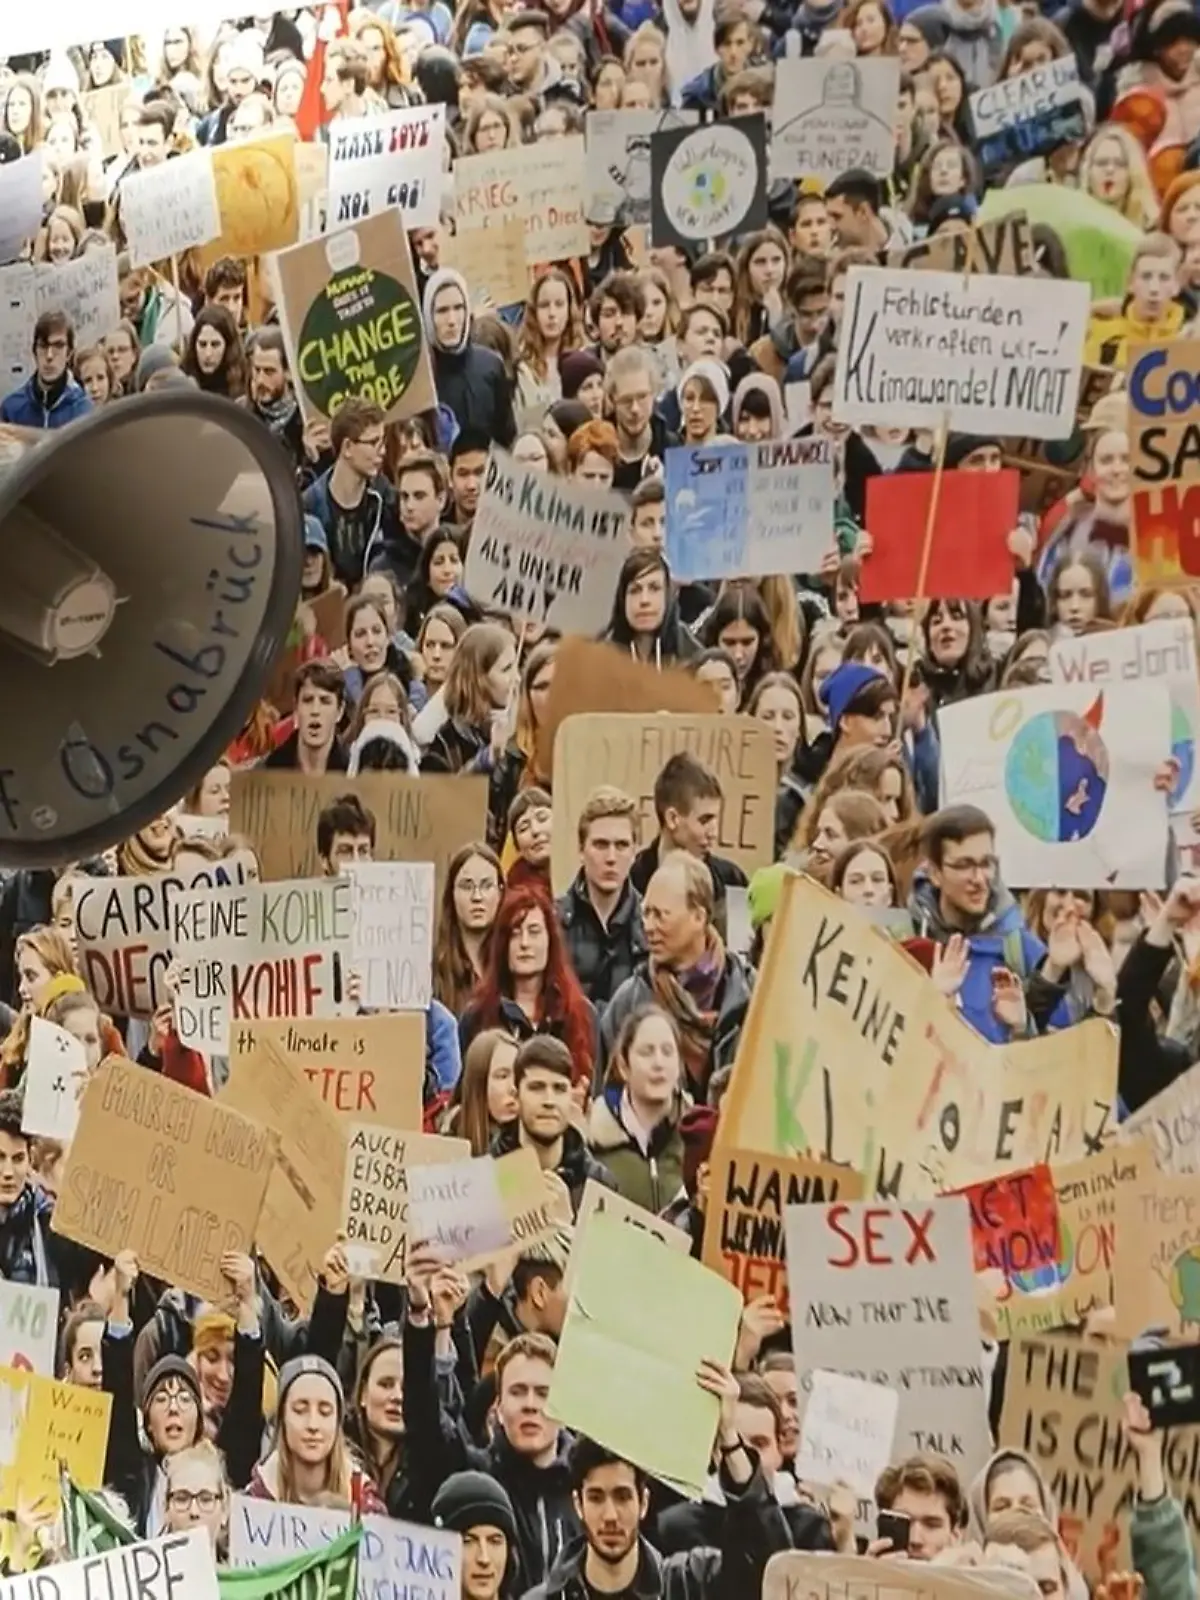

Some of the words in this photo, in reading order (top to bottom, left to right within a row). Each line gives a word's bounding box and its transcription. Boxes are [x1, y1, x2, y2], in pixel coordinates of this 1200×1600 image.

[977, 73, 1046, 119] CLEAR
[334, 129, 384, 160] MAKE
[388, 120, 428, 153] LOVE
[337, 188, 370, 222] NOT
[882, 287, 1024, 327] Fehlstunden
[299, 301, 416, 382] CHANGE
[845, 281, 998, 408] Klimawandel
[886, 327, 992, 357] verkraften
[328, 364, 405, 416] GOBE
[345, 360, 377, 384] THE
[485, 456, 514, 503] DAS
[518, 472, 586, 534] KLIMA
[591, 511, 625, 541] IST
[480, 534, 511, 570] ALS
[519, 551, 582, 595] UNSER
[61, 508, 264, 800] Osnabrück
[1058, 648, 1110, 683] We
[640, 726, 759, 779] FUTURE
[640, 795, 760, 850] FLE
[174, 896, 248, 943] KEINE
[261, 884, 349, 945] KOHLE
[802, 917, 906, 1066] KEINE
[180, 1006, 222, 1043] DIE
[237, 1030, 257, 1055] th
[280, 1027, 338, 1054] limate
[352, 1032, 365, 1055] is
[101, 1066, 200, 1145] MARCH
[205, 1106, 271, 1174] NOW
[147, 1141, 179, 1195] OR
[350, 1130, 406, 1163] AUCH
[726, 1160, 839, 1216] WANN
[1058, 1156, 1137, 1205] eminder
[63, 1165, 140, 1250] SWIM
[347, 1216, 392, 1244] BALD
[826, 1205, 937, 1268] SEX
[8, 1294, 48, 1338] NO
[1020, 1340, 1100, 1399] THE
[909, 1431, 964, 1455] TALK
[1023, 1407, 1062, 1458] IS
[243, 1506, 308, 1550] WIR
